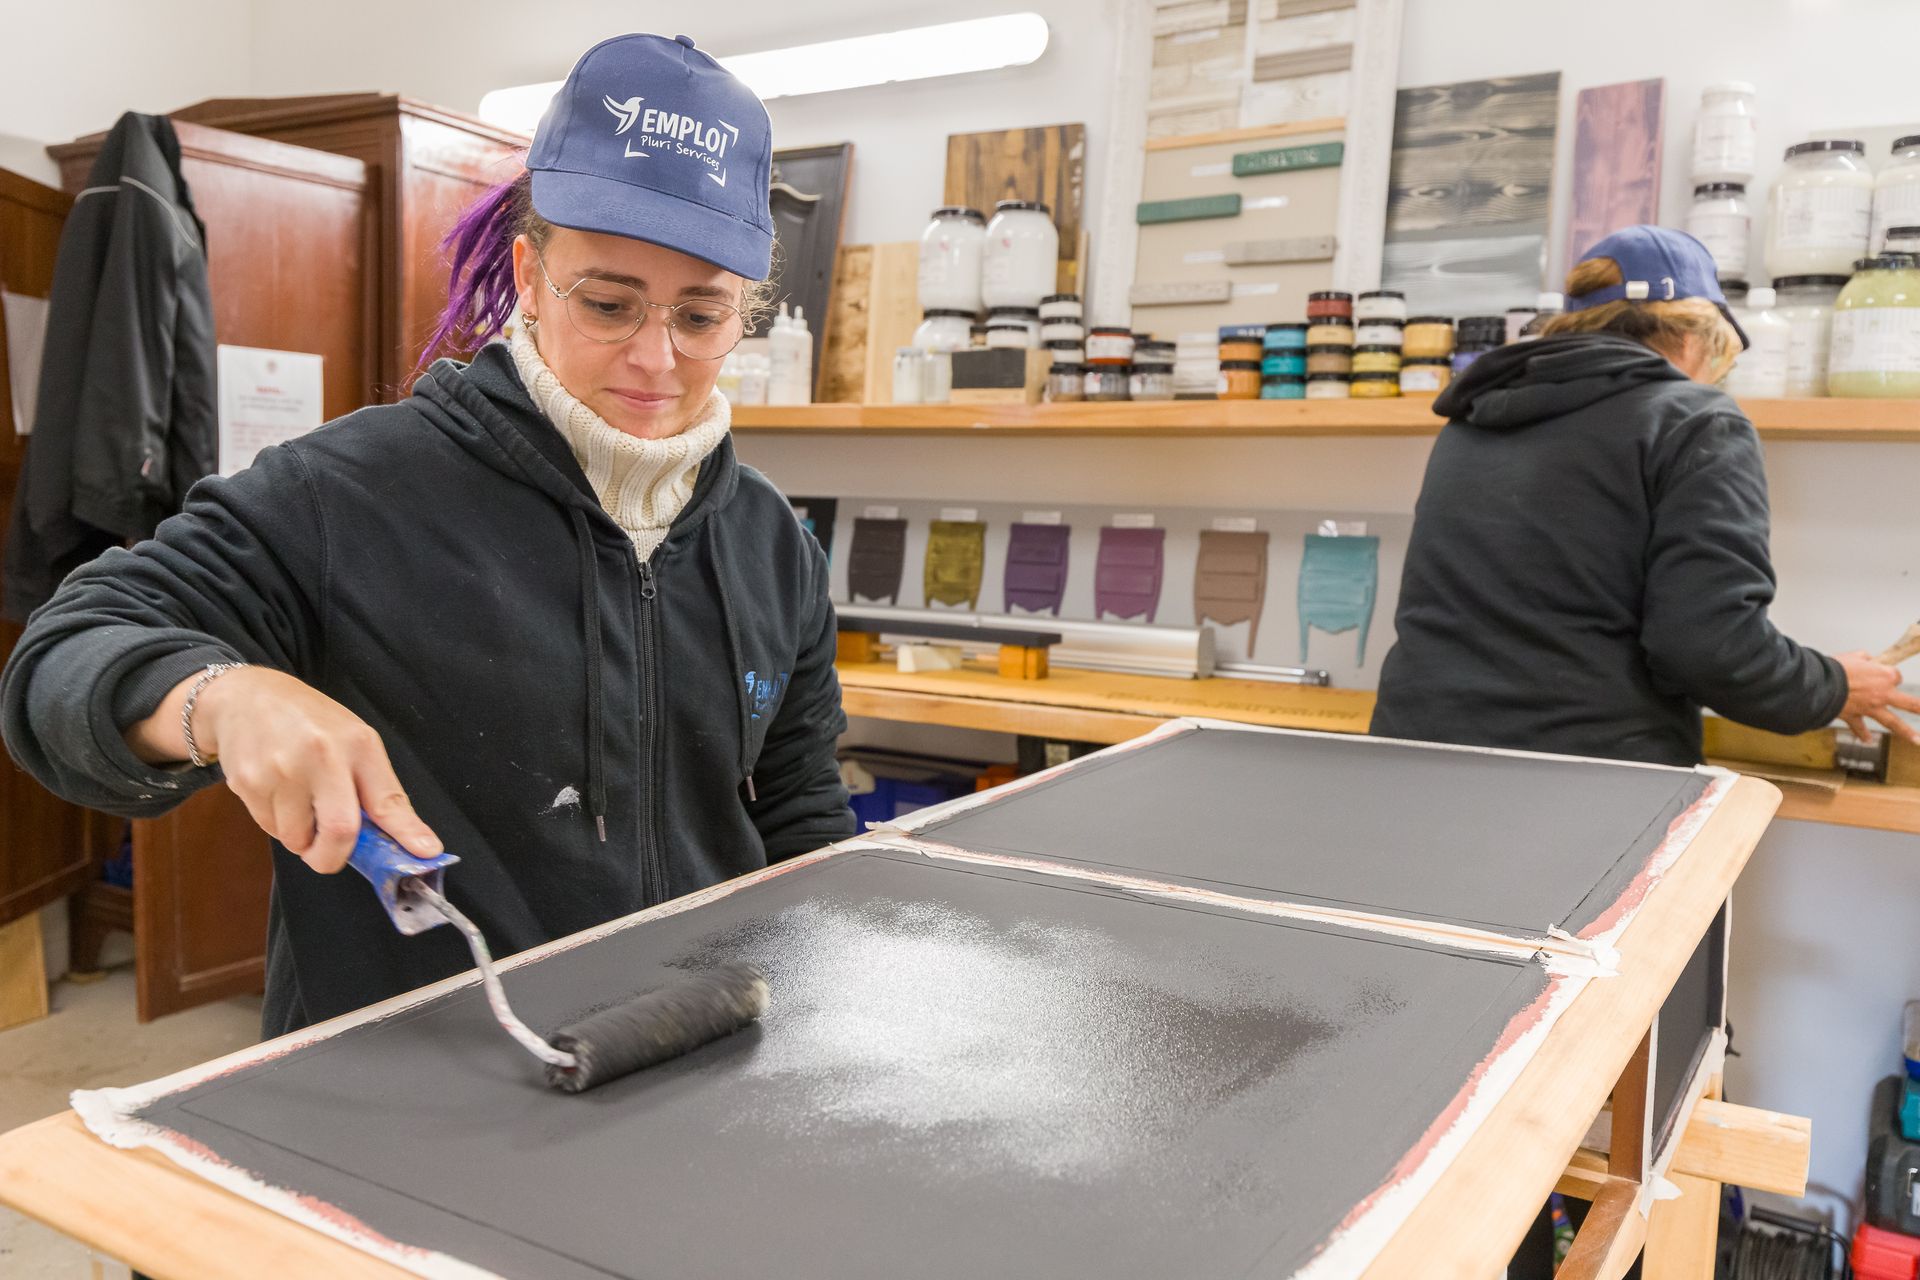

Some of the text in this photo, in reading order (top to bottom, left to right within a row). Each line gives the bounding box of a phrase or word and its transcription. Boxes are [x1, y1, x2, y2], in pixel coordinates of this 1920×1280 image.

[641, 109, 728, 158] EMPLOI
[641, 135, 720, 170] Pluri Services
